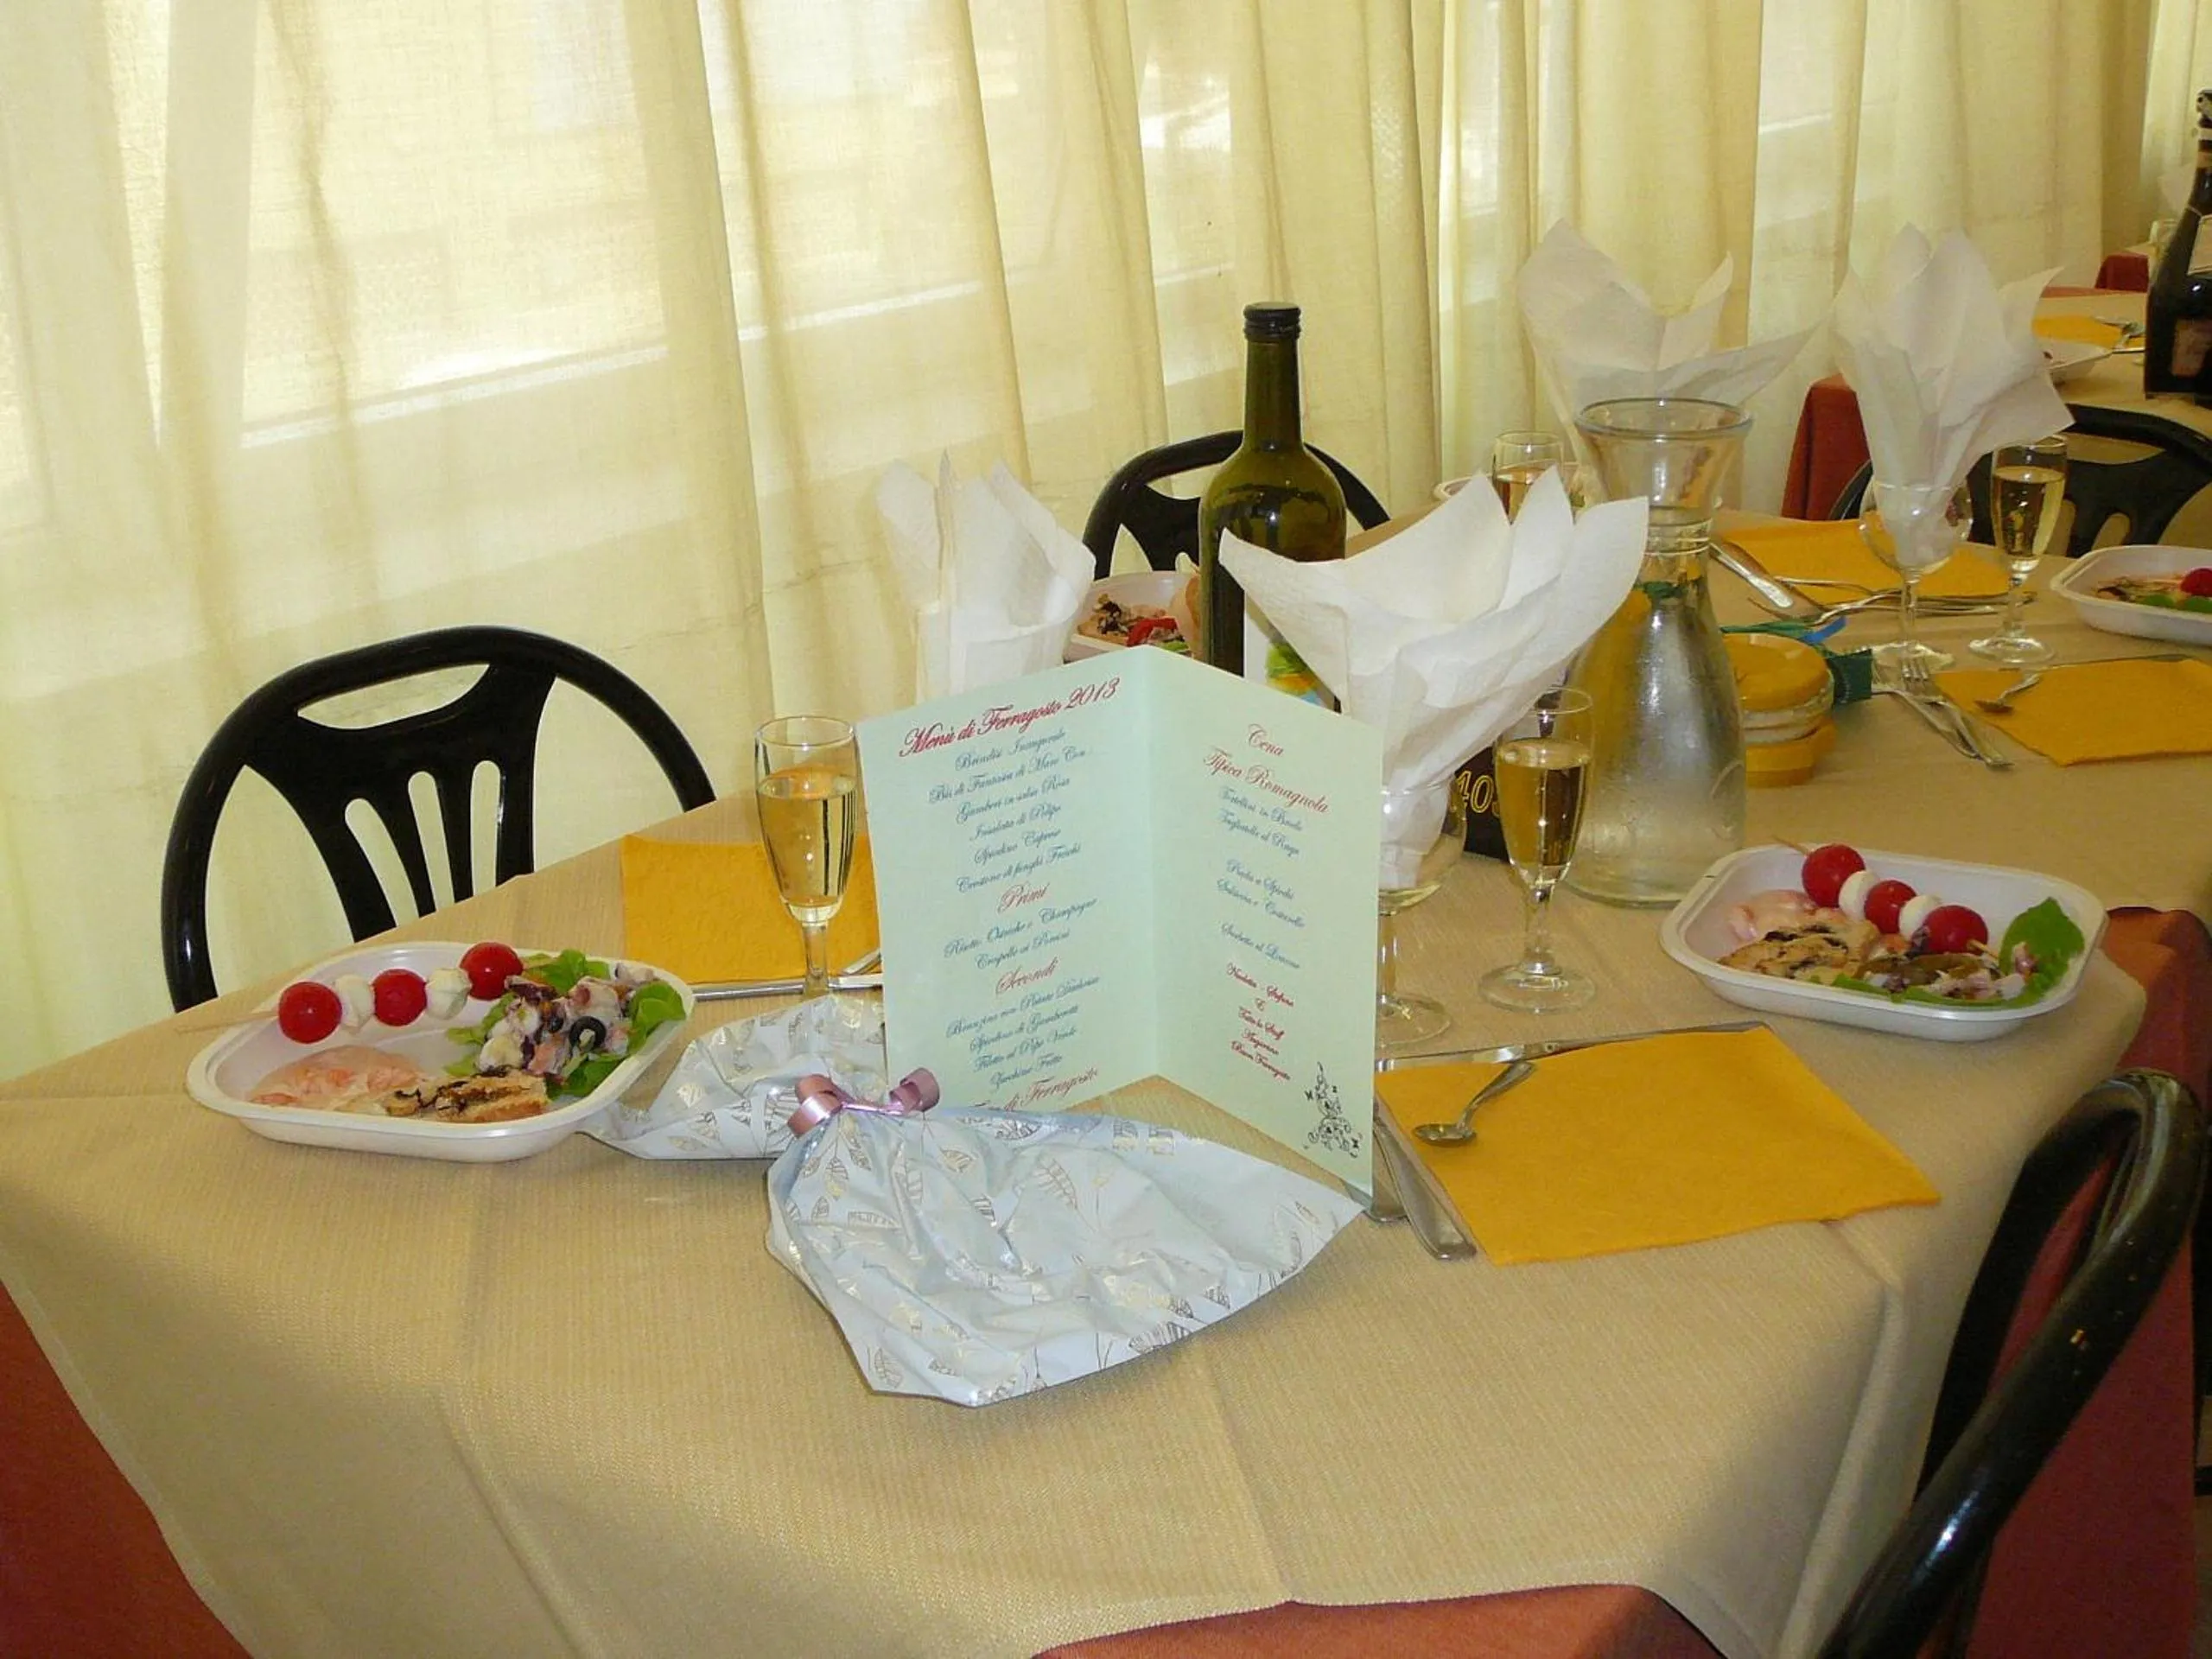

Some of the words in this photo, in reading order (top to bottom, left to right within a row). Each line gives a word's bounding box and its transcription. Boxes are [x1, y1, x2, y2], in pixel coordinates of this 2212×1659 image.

[954, 719, 976, 741] di
[977, 703, 1062, 735] Ferragosto
[1062, 677, 1121, 709] 2013
[1248, 723, 1285, 757] Cena
[1245, 764, 1330, 814] Romagnola
[997, 881, 1051, 914] Primi
[995, 955, 1060, 996] Secondi
